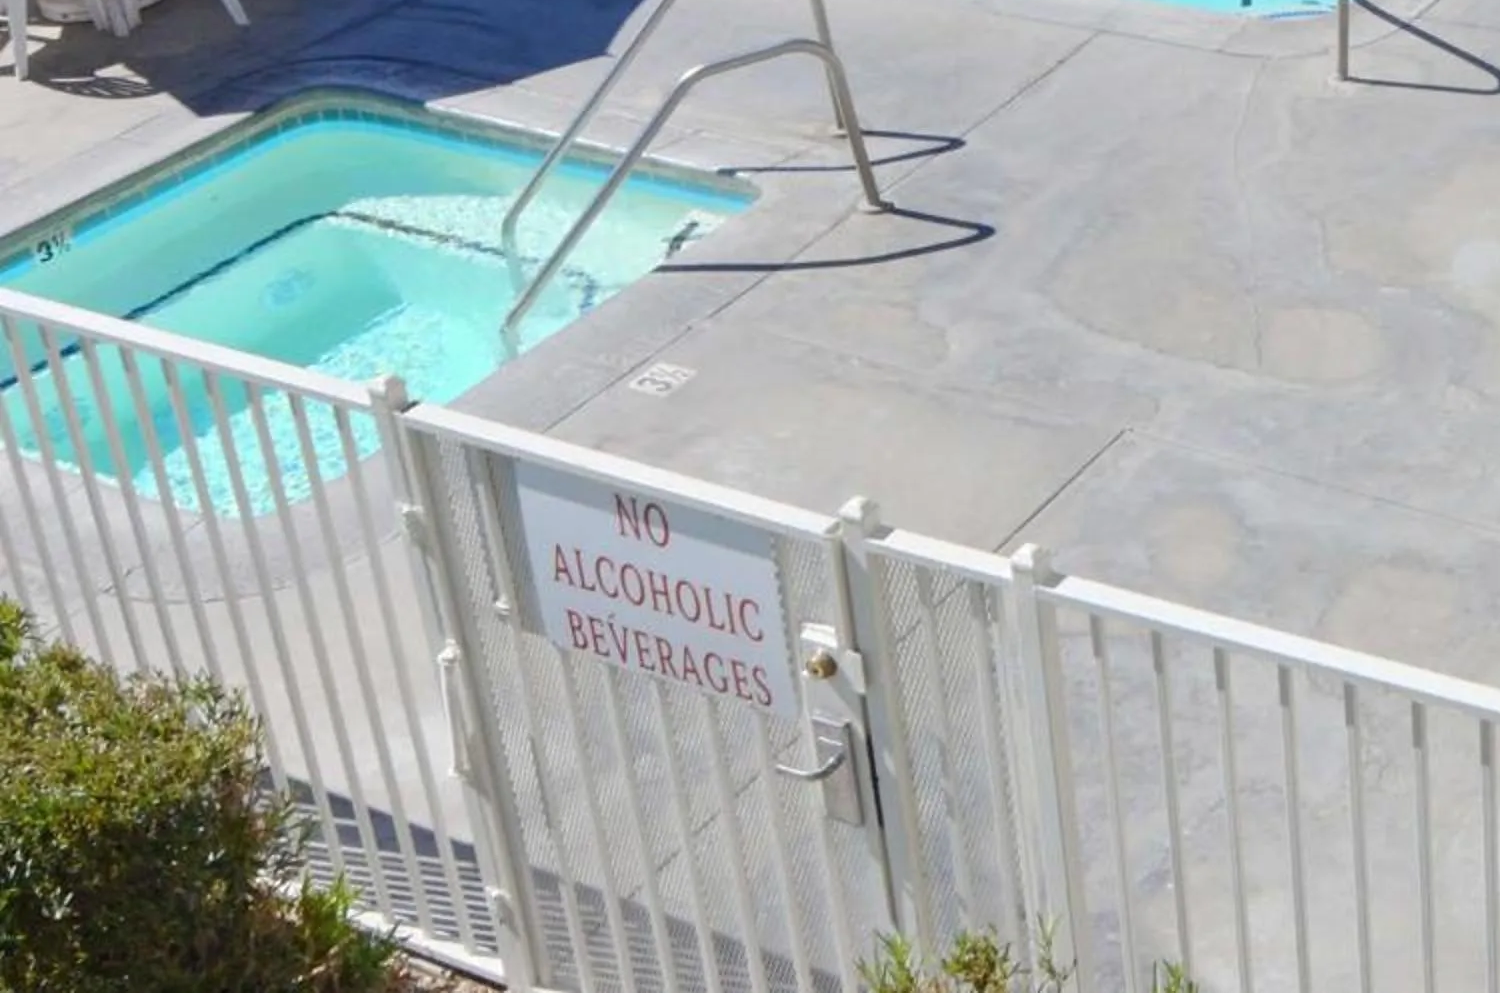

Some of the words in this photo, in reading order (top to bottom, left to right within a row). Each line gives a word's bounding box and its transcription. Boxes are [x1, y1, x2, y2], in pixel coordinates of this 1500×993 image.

[613, 493, 670, 547] NO
[553, 542, 764, 642] ALCOHOLIC
[566, 609, 773, 707] BEVERAGES
